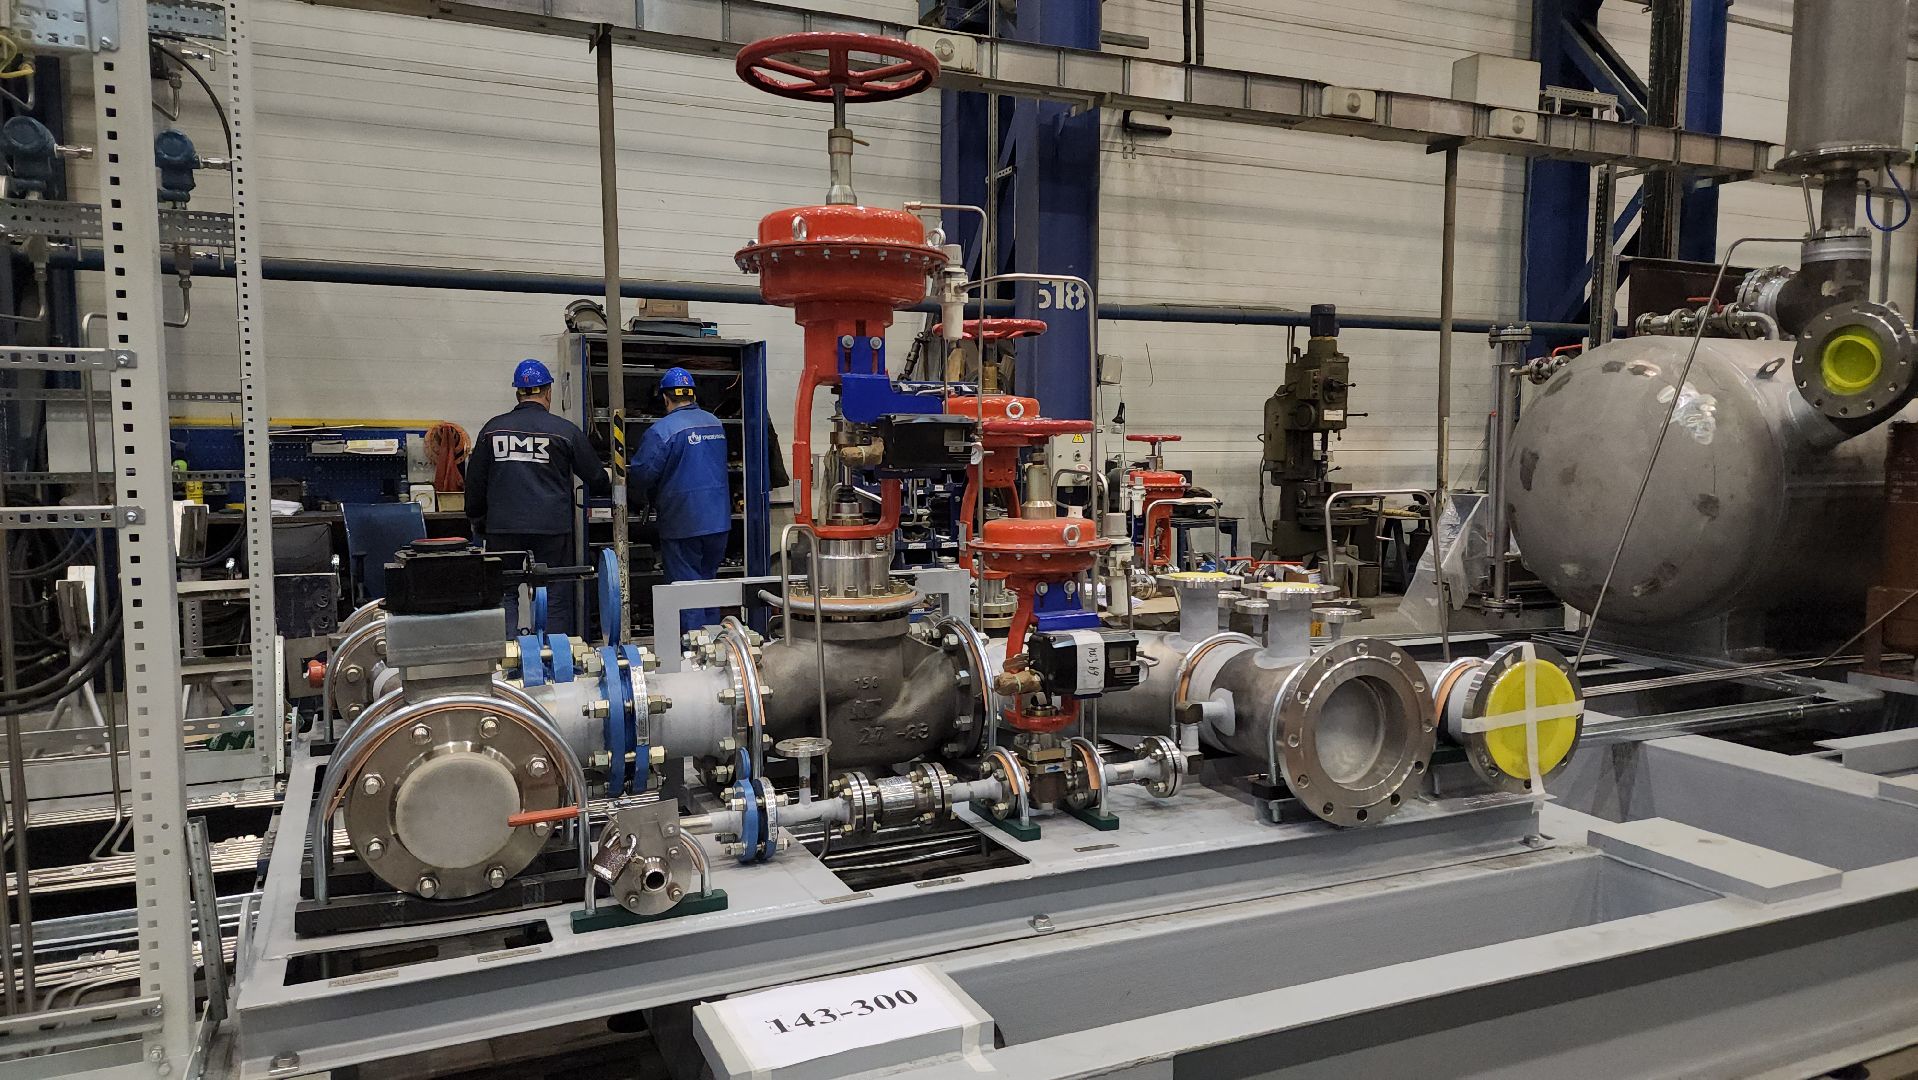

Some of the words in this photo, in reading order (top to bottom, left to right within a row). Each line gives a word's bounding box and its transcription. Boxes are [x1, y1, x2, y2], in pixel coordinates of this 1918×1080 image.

[1038, 280, 1086, 311] 518
[493, 436, 549, 460] ОМЗ
[765, 989, 918, 1035] 143-300
